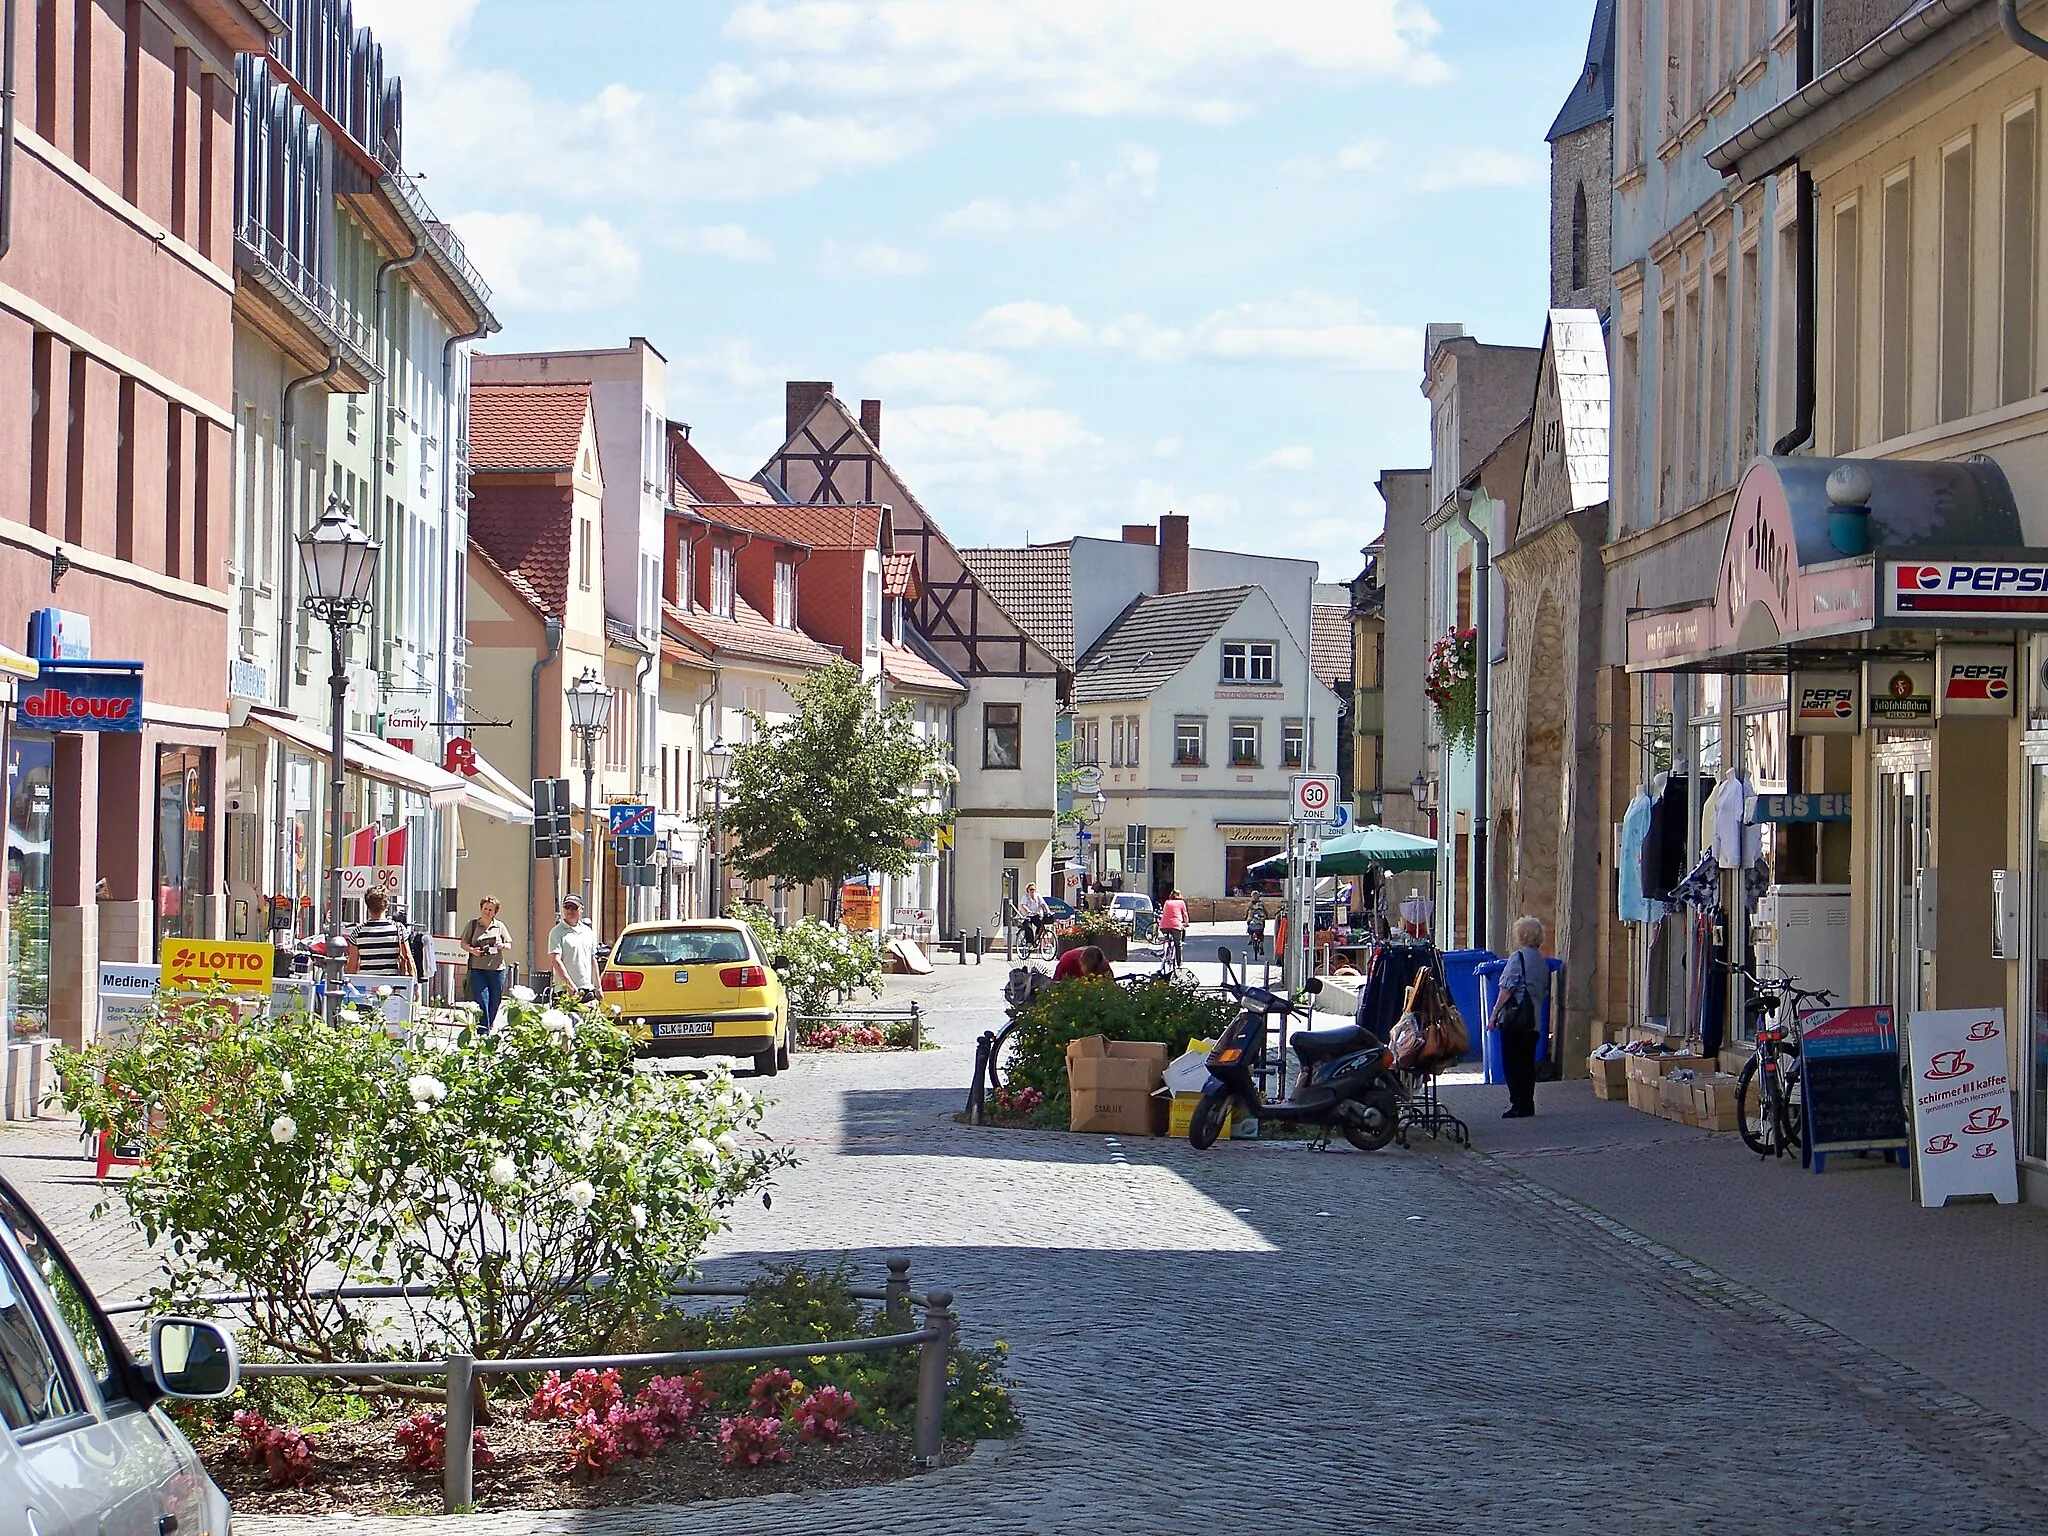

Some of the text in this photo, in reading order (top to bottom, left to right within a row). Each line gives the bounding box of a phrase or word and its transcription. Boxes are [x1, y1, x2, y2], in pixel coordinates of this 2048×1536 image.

[1947, 566, 2048, 591] PEPSI
[1950, 664, 2008, 678] PEPSI
[1803, 689, 1852, 700] PEPSI
[24, 689, 133, 719] alltours
[1801, 701, 1831, 709] LIGHT
[388, 714, 428, 731] family
[1306, 788, 1323, 801] 30
[1769, 795, 1809, 817] EIS
[1303, 810, 1325, 818] ZONE
[1229, 830, 1282, 841] Lederwaren
[199, 951, 264, 971] LOTTO
[660, 1022, 712, 1034] SLK PA 204
[1918, 1075, 2007, 1106] schirmer kaffee
[1954, 1097, 1970, 1106] nach
[1970, 1087, 2005, 1102] Herzenslust
